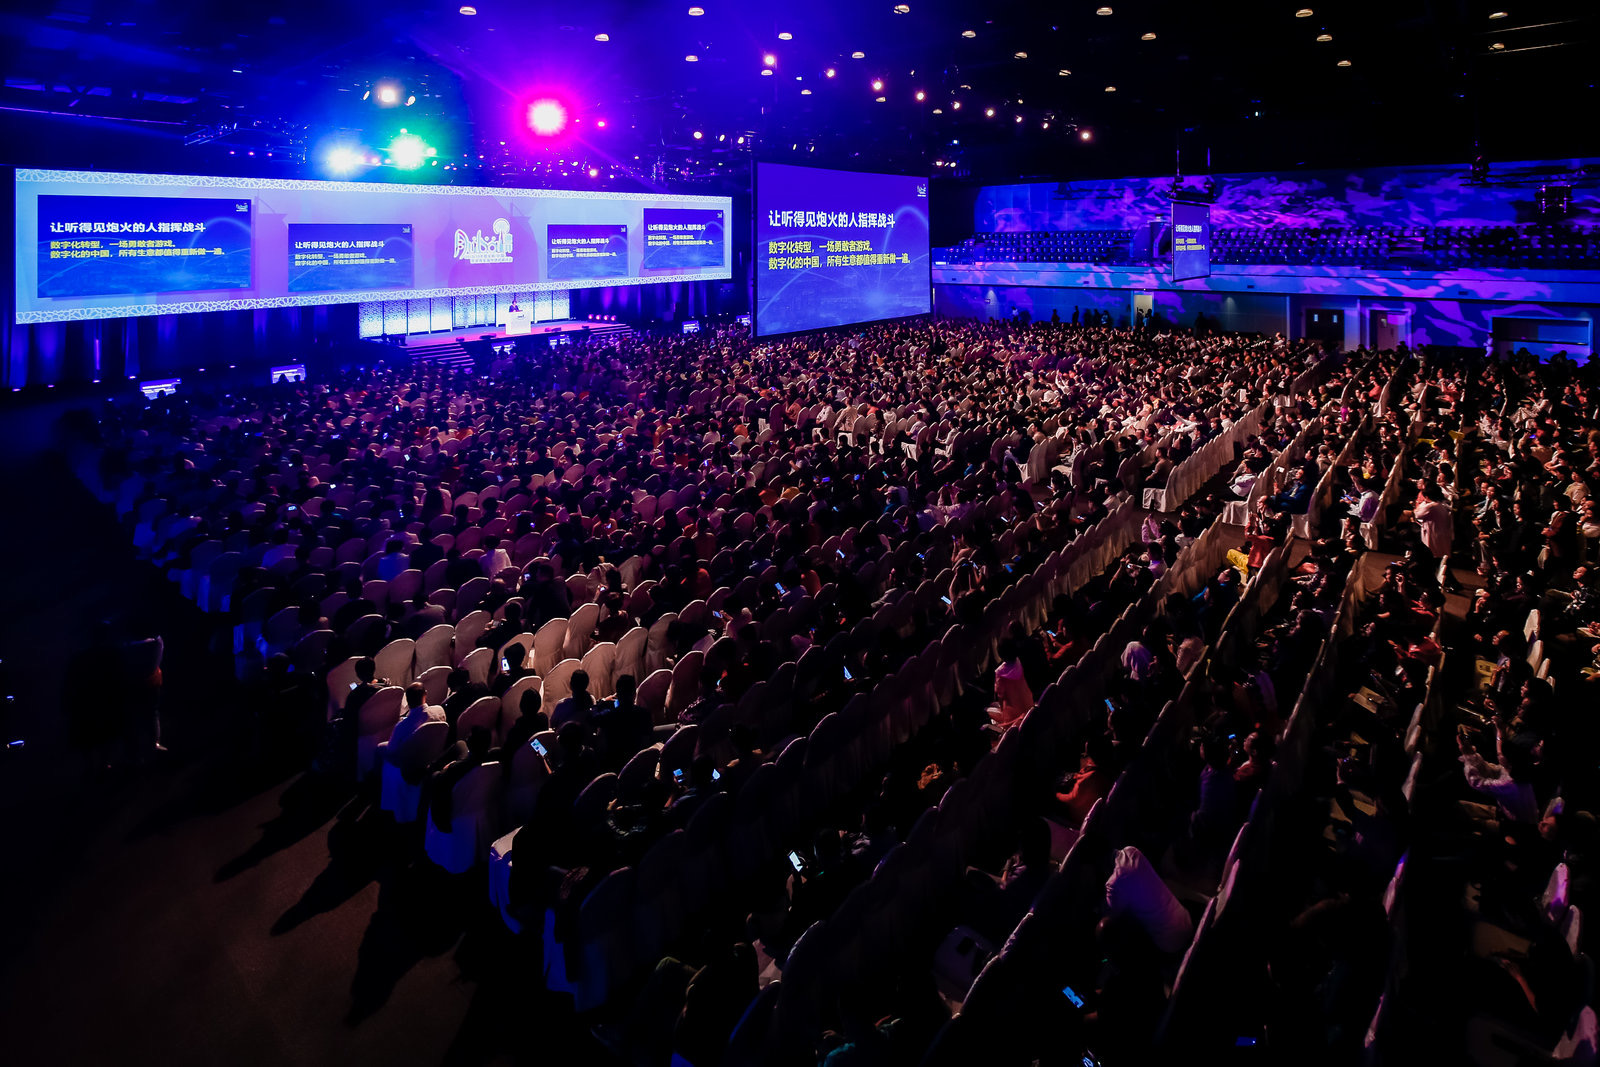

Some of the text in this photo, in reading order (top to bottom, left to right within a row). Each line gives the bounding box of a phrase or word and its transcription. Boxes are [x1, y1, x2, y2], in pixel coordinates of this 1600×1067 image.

[768, 210, 896, 228] 让听得见炮火的人指挥战斗
[50, 222, 206, 233] 让听得见炮火的人指挥战斗
[768, 241, 873, 254] 数字化转型，一场勇敢者游戏。
